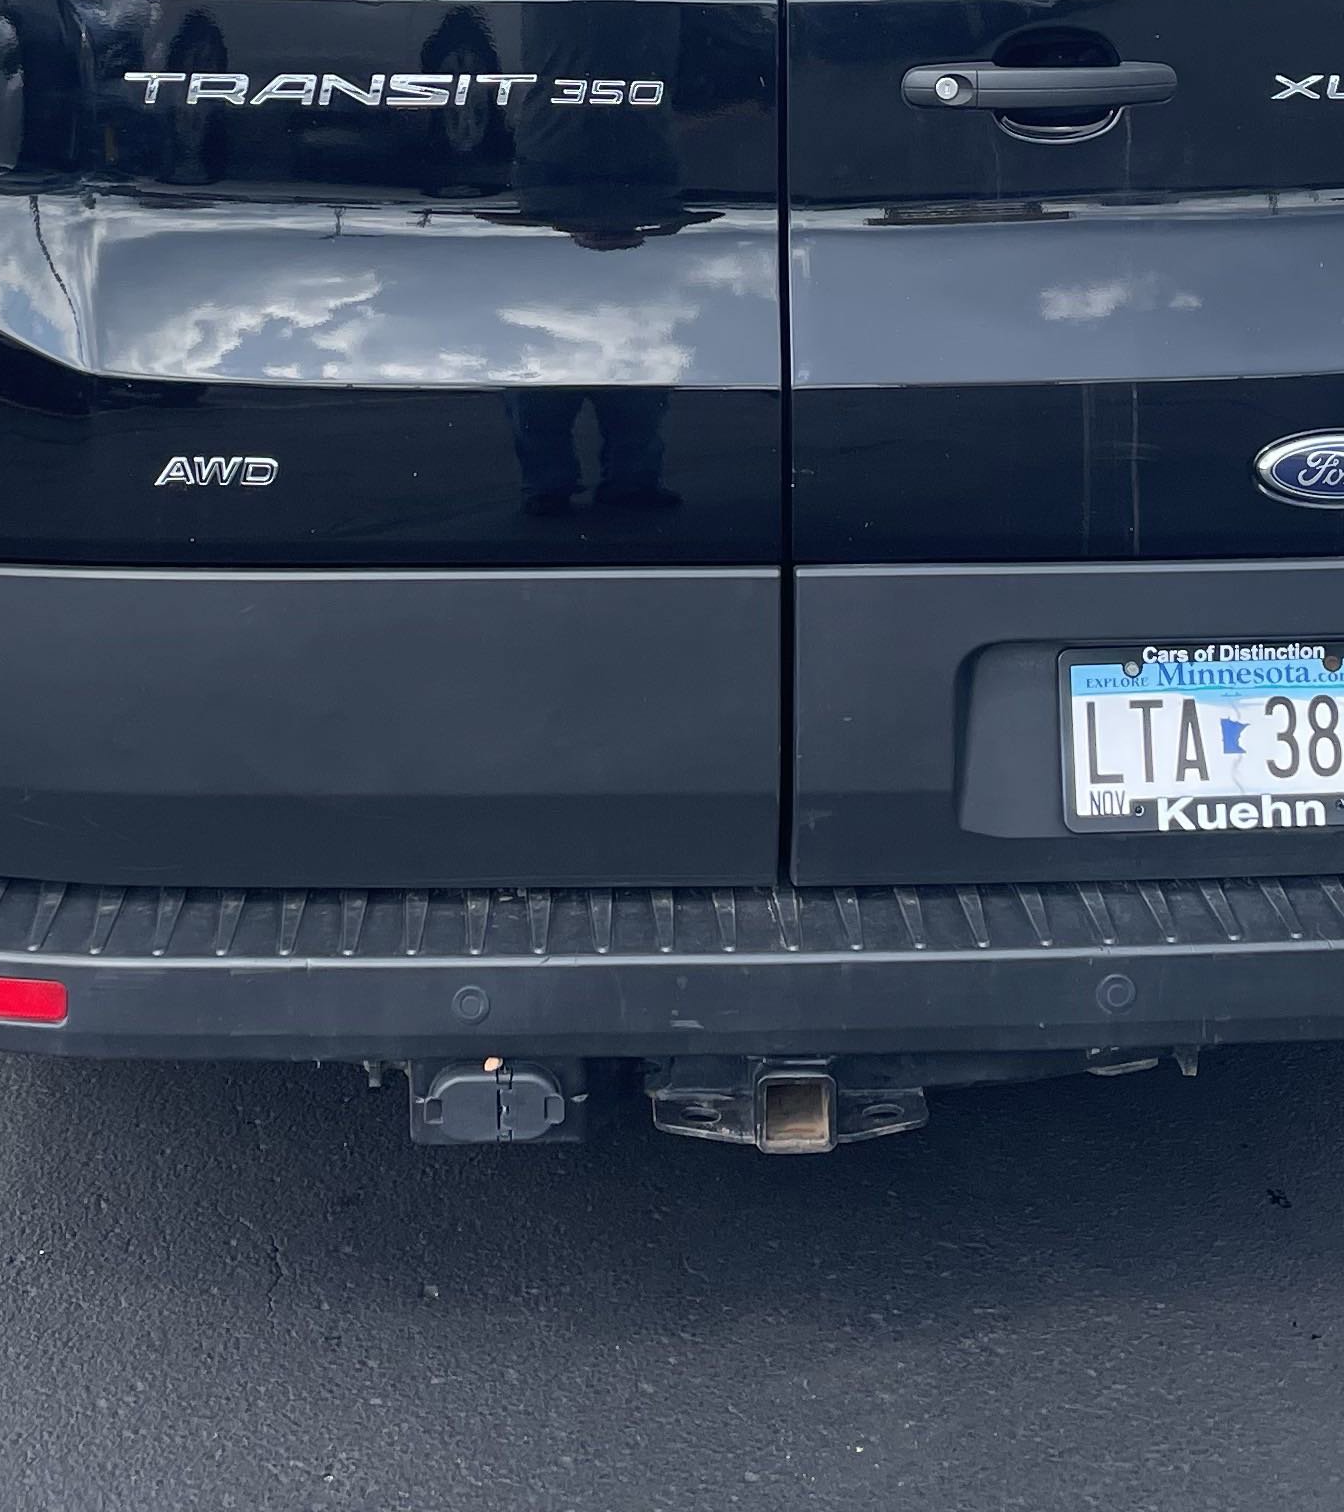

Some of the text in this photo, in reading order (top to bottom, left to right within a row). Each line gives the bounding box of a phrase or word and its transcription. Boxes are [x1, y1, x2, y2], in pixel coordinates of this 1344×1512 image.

[124, 72, 664, 106] TRANSIT 350
[154, 456, 279, 486] AWD
[1142, 643, 1325, 663] Cars of Distinction
[1086, 676, 1149, 688] EXPLORE
[1086, 699, 1210, 785] LTA
[1089, 790, 1126, 816] NOV
[1156, 794, 1327, 832] Kuehn
